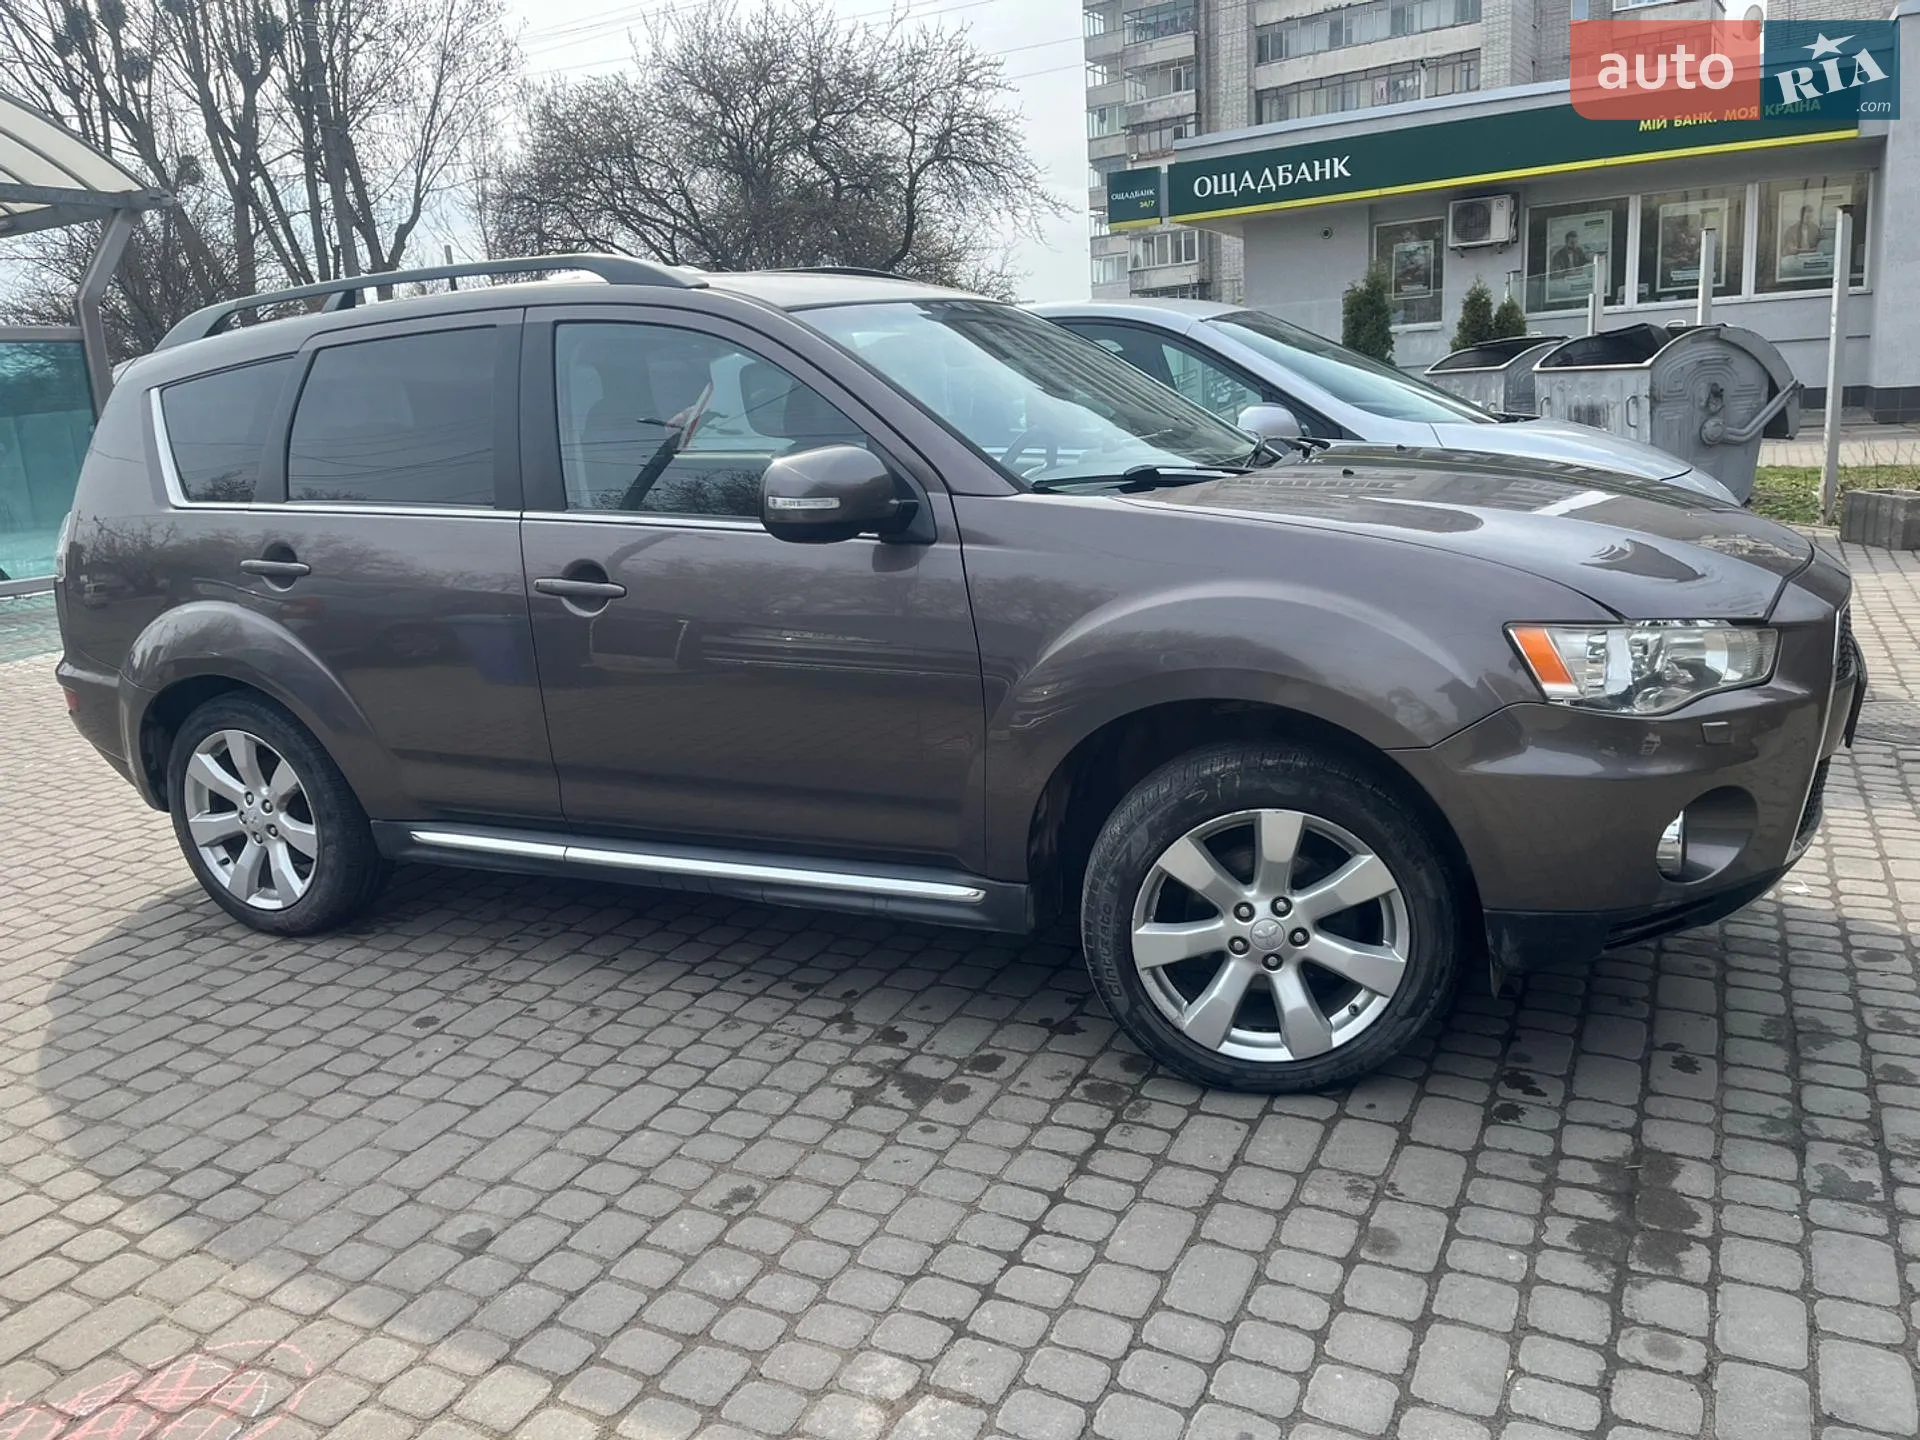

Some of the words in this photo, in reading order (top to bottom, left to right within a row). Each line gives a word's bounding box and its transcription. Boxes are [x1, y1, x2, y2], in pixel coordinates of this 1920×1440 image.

[1638, 115, 1667, 132] МІЙ
[1724, 105, 1759, 122] МОЯ
[1193, 155, 1352, 198] ОЩАДБАНК
